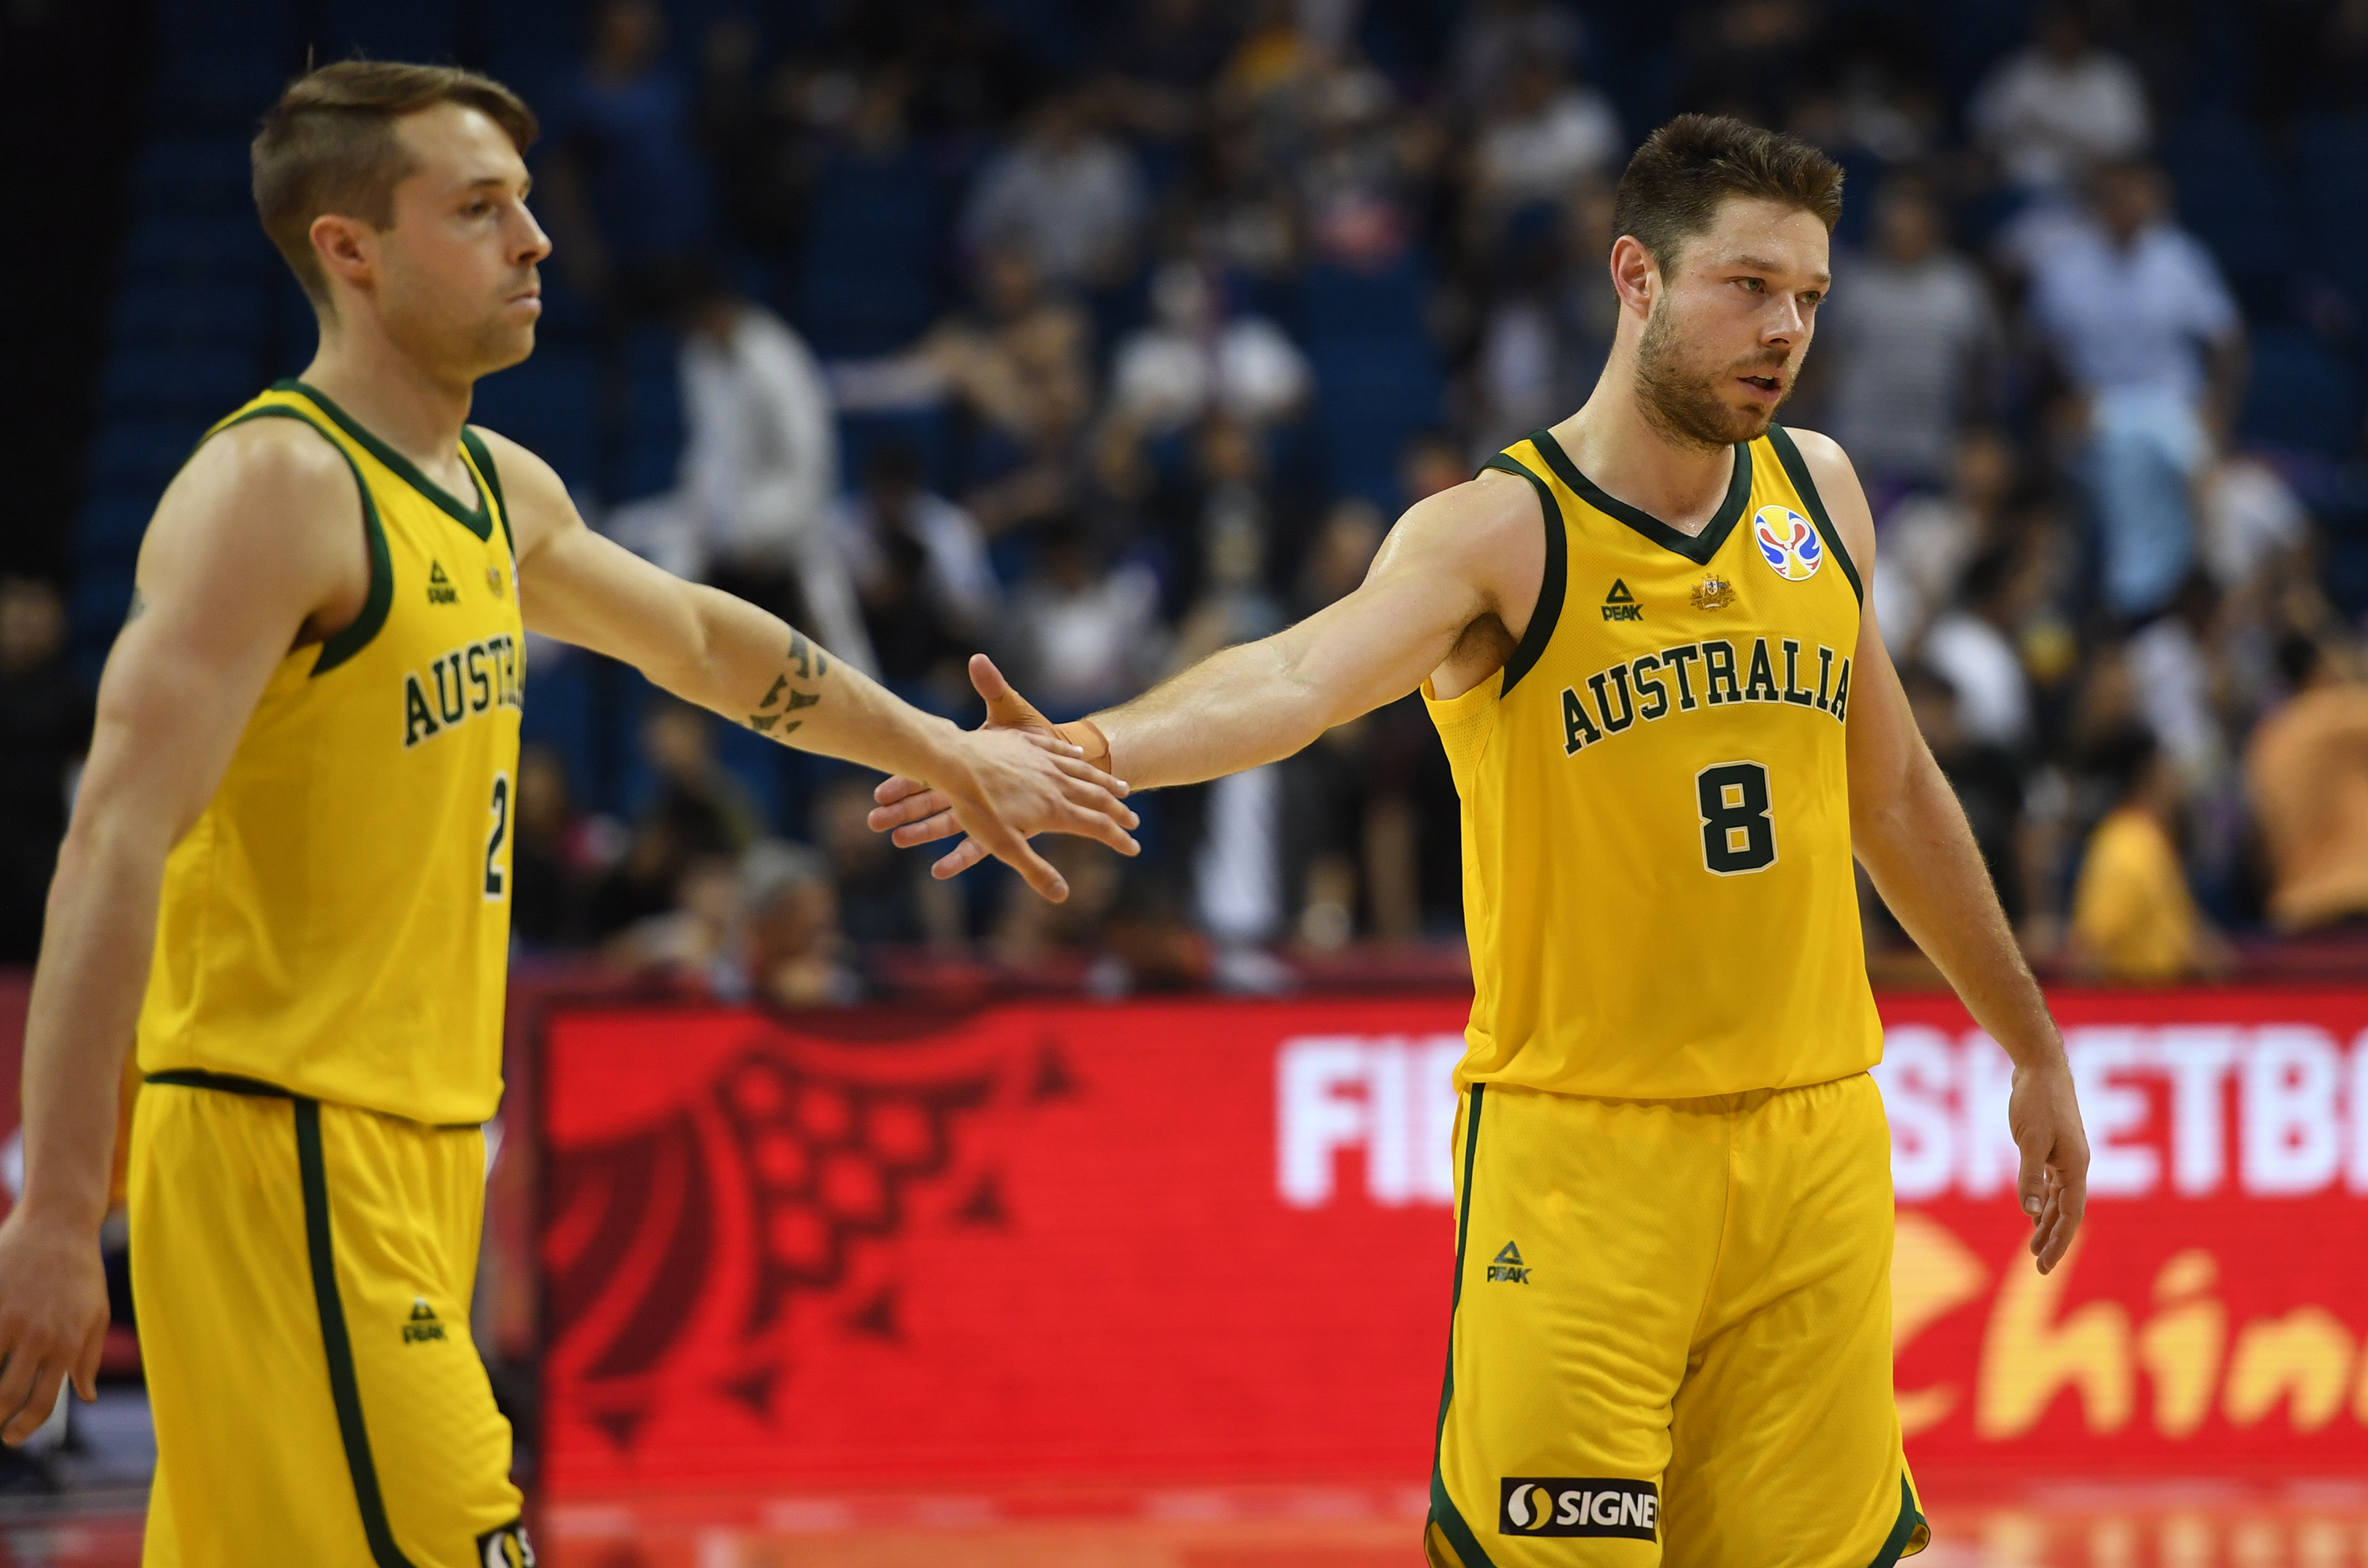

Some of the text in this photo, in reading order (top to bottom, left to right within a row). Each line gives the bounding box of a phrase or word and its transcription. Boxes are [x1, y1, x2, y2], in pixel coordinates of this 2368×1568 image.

[1601, 604, 1644, 622] PEAK
[1560, 637, 1850, 758] AUSTRALIA
[483, 771, 508, 901] 2
[1695, 759, 1778, 877] 8
[1879, 1024, 2368, 1201] SKETB
[1487, 1265, 1532, 1285] PEAK
[1891, 1209, 2368, 1441] hin
